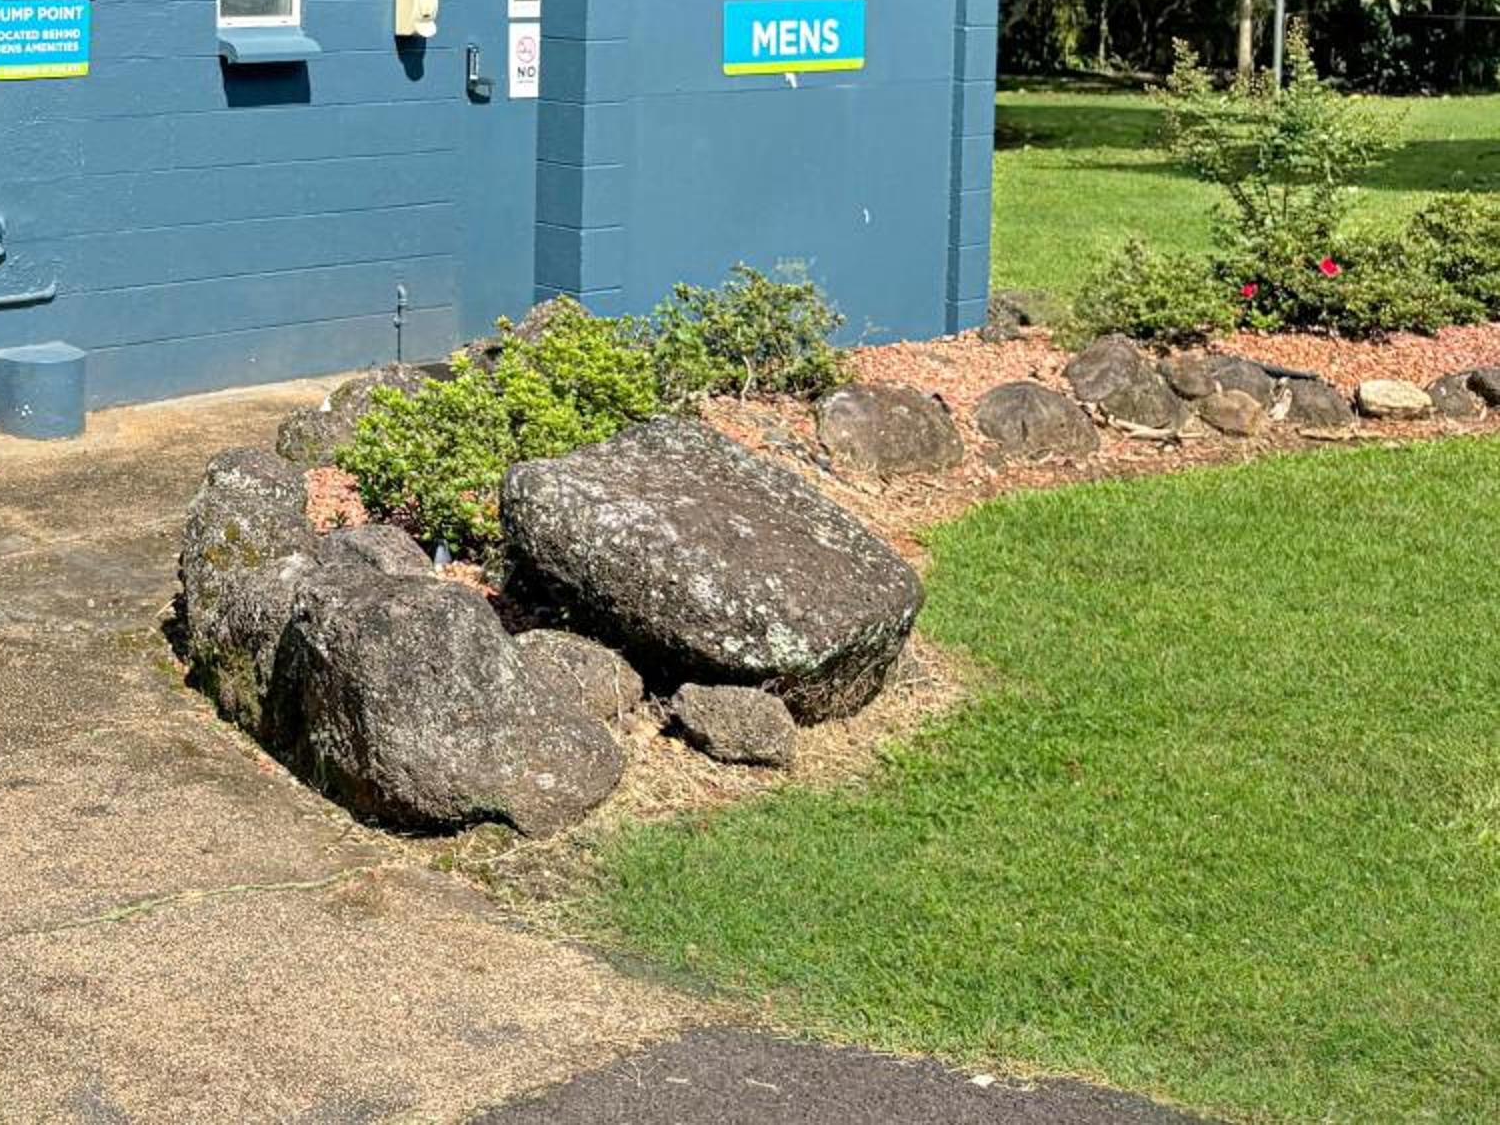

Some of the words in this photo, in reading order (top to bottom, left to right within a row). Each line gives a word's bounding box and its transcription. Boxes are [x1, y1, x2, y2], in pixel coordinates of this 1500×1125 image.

[37, 6, 85, 21] POINT
[42, 28, 81, 40] BEHIND
[752, 18, 840, 57] MENS
[24, 41, 79, 53] AMENITIES
